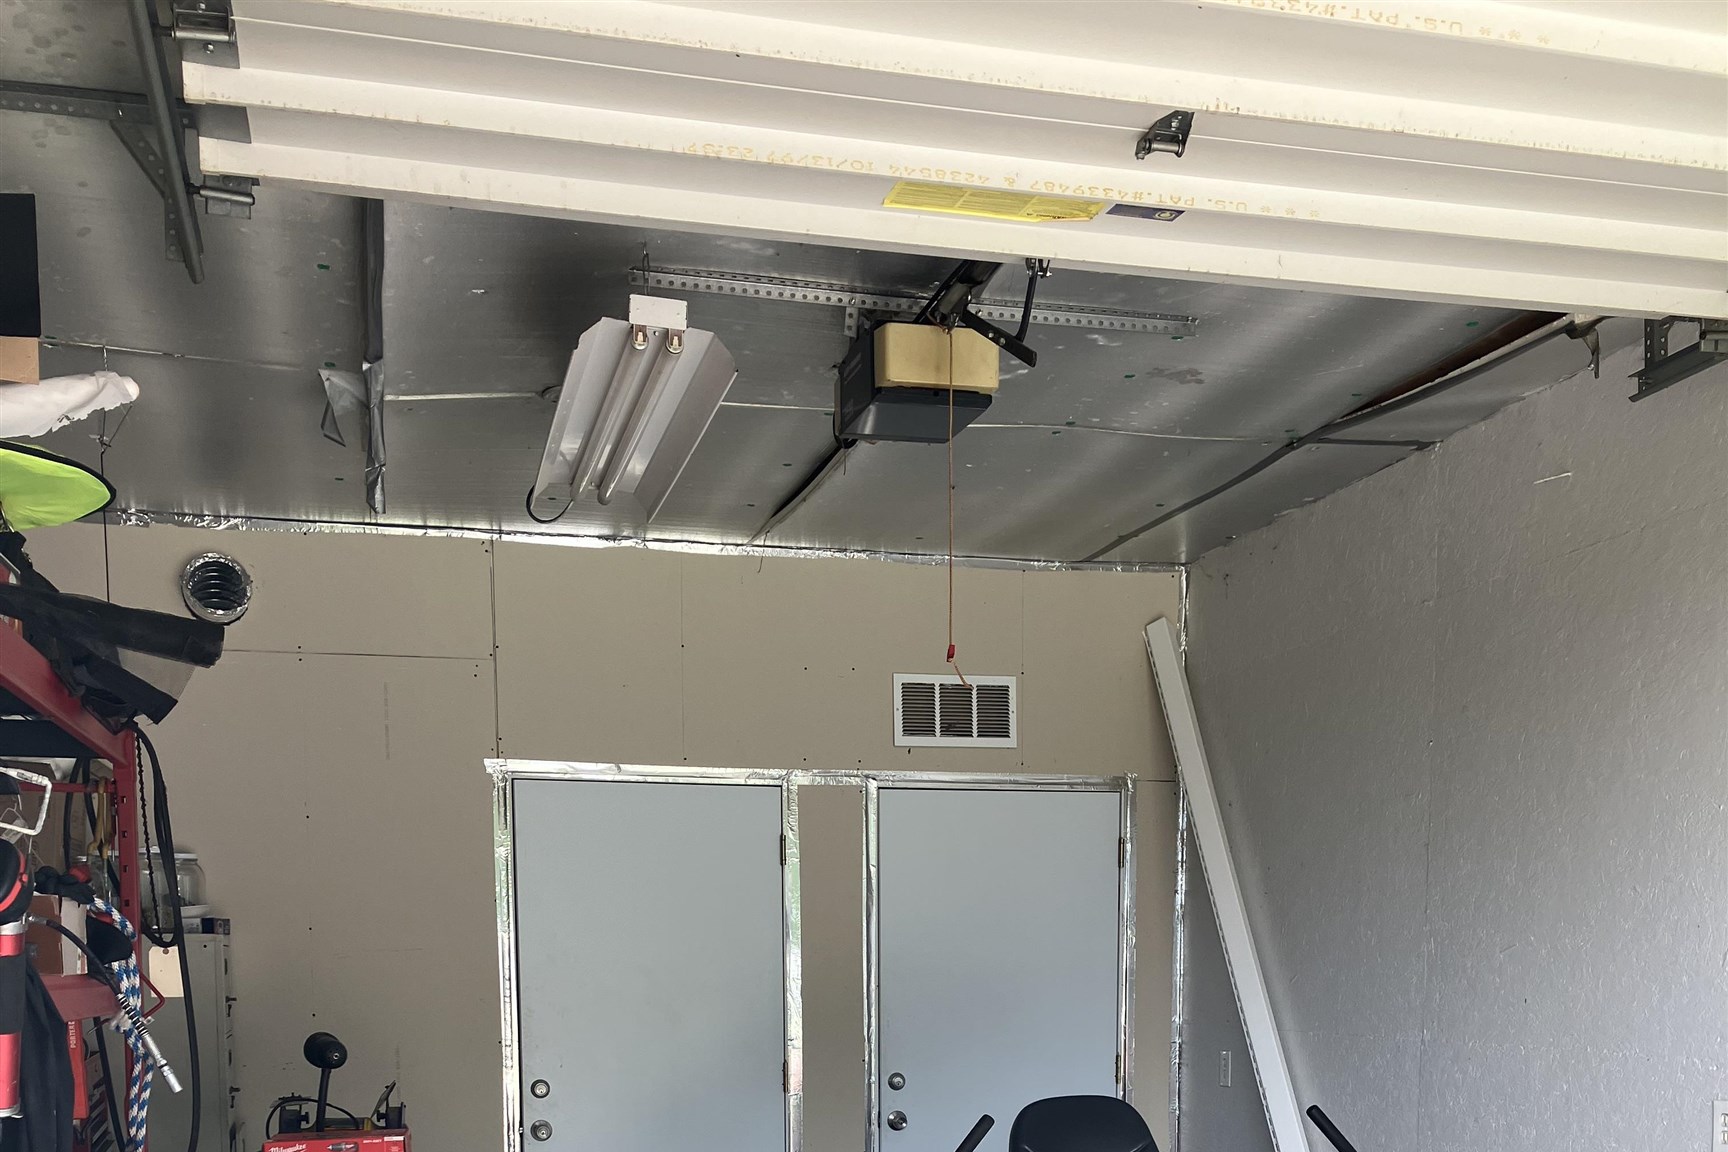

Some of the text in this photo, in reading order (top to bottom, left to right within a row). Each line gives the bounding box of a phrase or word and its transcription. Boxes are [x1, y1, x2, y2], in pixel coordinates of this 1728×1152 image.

[888, 164, 990, 185] 4238544
[1003, 176, 1016, 188] &
[1030, 180, 1195, 207] PAT.#4339487
[1207, 198, 1249, 213] U.S.
